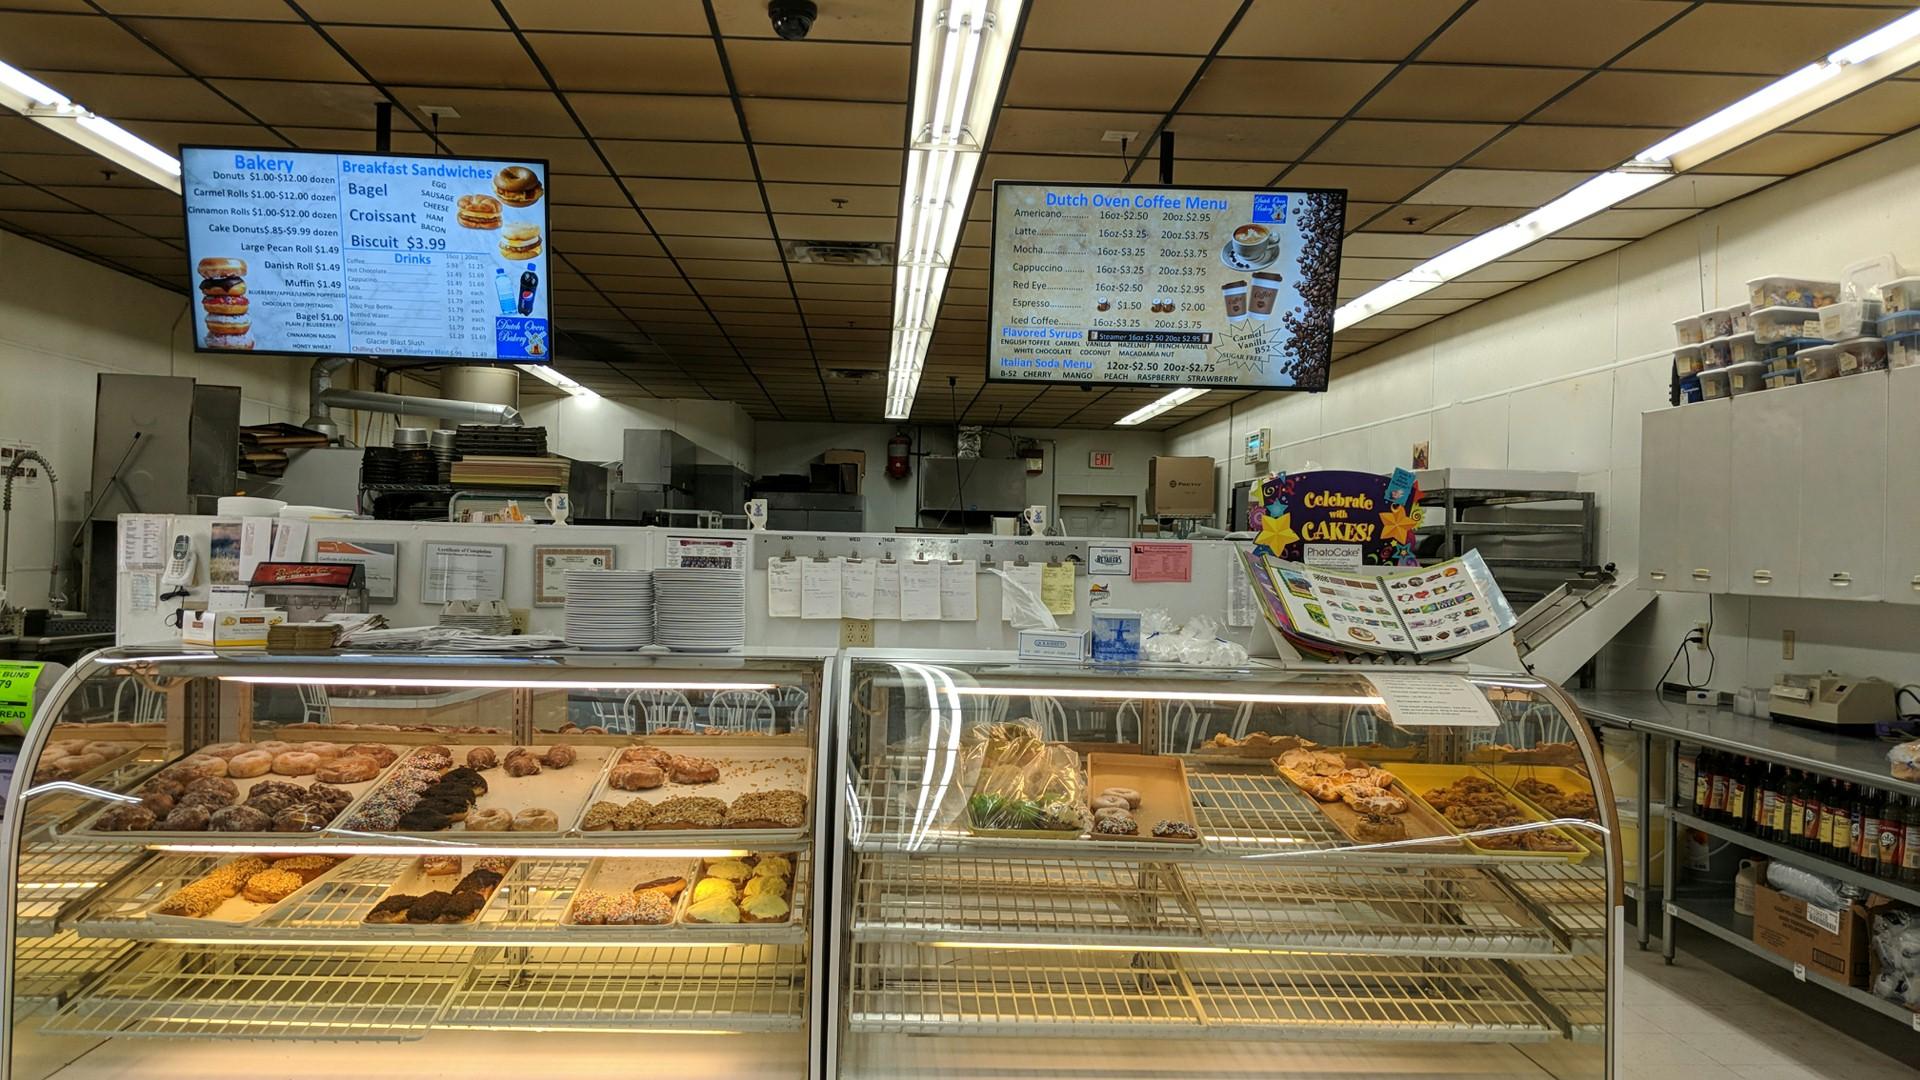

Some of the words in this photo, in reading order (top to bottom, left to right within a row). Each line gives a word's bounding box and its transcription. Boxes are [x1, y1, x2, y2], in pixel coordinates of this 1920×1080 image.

[235, 155, 294, 173] Bakery
[342, 160, 407, 175] Breakfast
[412, 162, 493, 179] Sandwiches
[213, 171, 245, 180] Donuts
[250, 172, 308, 183] $1.00-$12.00
[310, 175, 336, 184] dozen
[348, 182, 388, 199] Bagel
[431, 180, 447, 189] EGG
[194, 188, 225, 197] Carmel
[227, 189, 249, 198] Rolls
[251, 190, 308, 201] $1.00-$12.00
[311, 193, 336, 201] dozen
[421, 189, 455, 203] SAUSAGE
[423, 201, 450, 213] CHEESE
[1046, 192, 1088, 208] Dutch
[1092, 194, 1130, 208] Oven
[1134, 194, 1181, 210] Coffee
[1185, 196, 1228, 211] Menu
[188, 206, 229, 215] Cinnamon
[231, 207, 250, 216] Rolls
[252, 208, 310, 219] $1.00-$12.00
[312, 211, 337, 219] dozen
[349, 209, 416, 224] Croissant
[426, 213, 444, 223] HAM
[1100, 210, 1149, 221] 16oz-$2.50
[1162, 212, 1211, 223] 20oz.$2.95
[209, 224, 230, 233] Cake
[313, 229, 338, 237] dozen
[420, 223, 447, 234] BACON
[1161, 230, 1210, 241] 20oz.$3.75
[241, 243, 265, 252] Large
[267, 244, 293, 253] Pecan
[296, 244, 313, 253] Roll
[314, 244, 339, 254] $1.49
[351, 235, 399, 249] Biscuit
[407, 236, 446, 251] $3.99
[394, 253, 431, 265] Drinks
[1097, 247, 1145, 258] 16oz-$3.25
[1160, 249, 1208, 259] 20oz.$3.75
[264, 261, 293, 270] Danish
[297, 261, 314, 270] Roll
[316, 262, 340, 272] $1.49
[1012, 263, 1063, 273] Cappuccino
[1096, 265, 1144, 276] 16oz-$3.25
[1159, 266, 1207, 278] 20oz.$3.75
[285, 279, 315, 288] Muffin
[317, 279, 341, 289] $1.49
[1012, 280, 1029, 289] Red
[1095, 283, 1143, 293] 16oz-$2.50
[1157, 284, 1205, 295] 20oz.$2.95
[1117, 301, 1142, 310] $1.50
[1181, 302, 1205, 312] $2.00
[296, 313, 319, 322] Bagel
[320, 313, 344, 322] $1.00
[1011, 316, 1029, 325] Iced
[1093, 318, 1140, 328] 16oz-$3.25
[1154, 320, 1202, 330] 20oz.$3.75
[496, 319, 521, 330] Dutch
[524, 320, 545, 330] Oven
[498, 330, 527, 346] Bakery
[1002, 327, 1046, 338] Flavored
[1049, 329, 1083, 339] Syrups
[1182, 335, 1200, 343] $2.95
[1232, 330, 1262, 343] Carmel
[366, 338, 388, 346] Glacier
[1000, 338, 1027, 346] ENGLISH
[1028, 339, 1050, 347] TOFFEE
[1237, 339, 1267, 350] Vanilla
[1119, 350, 1160, 358] MACADAMIA
[1255, 345, 1271, 355] B52
[1222, 352, 1244, 361] SUGAR
[1246, 354, 1262, 362] FREE
[1000, 358, 1033, 368] Italian
[1035, 359, 1060, 369] Soda
[1063, 359, 1092, 370] Menu
[1107, 362, 1158, 373] 12oz-$2.50
[1163, 363, 1215, 374] 20oz-$2.75
[1023, 371, 1052, 379] CHERRY
[1137, 374, 1180, 382] RASPBERRY
[1187, 375, 1238, 383] STRAWBERRY
[1095, 453, 1113, 466] EXIT
[1304, 490, 1374, 510] Celebrate
[1329, 510, 1348, 519] with
[1301, 521, 1375, 542] CAKES!
[2, 671, 30, 680] BUNS
